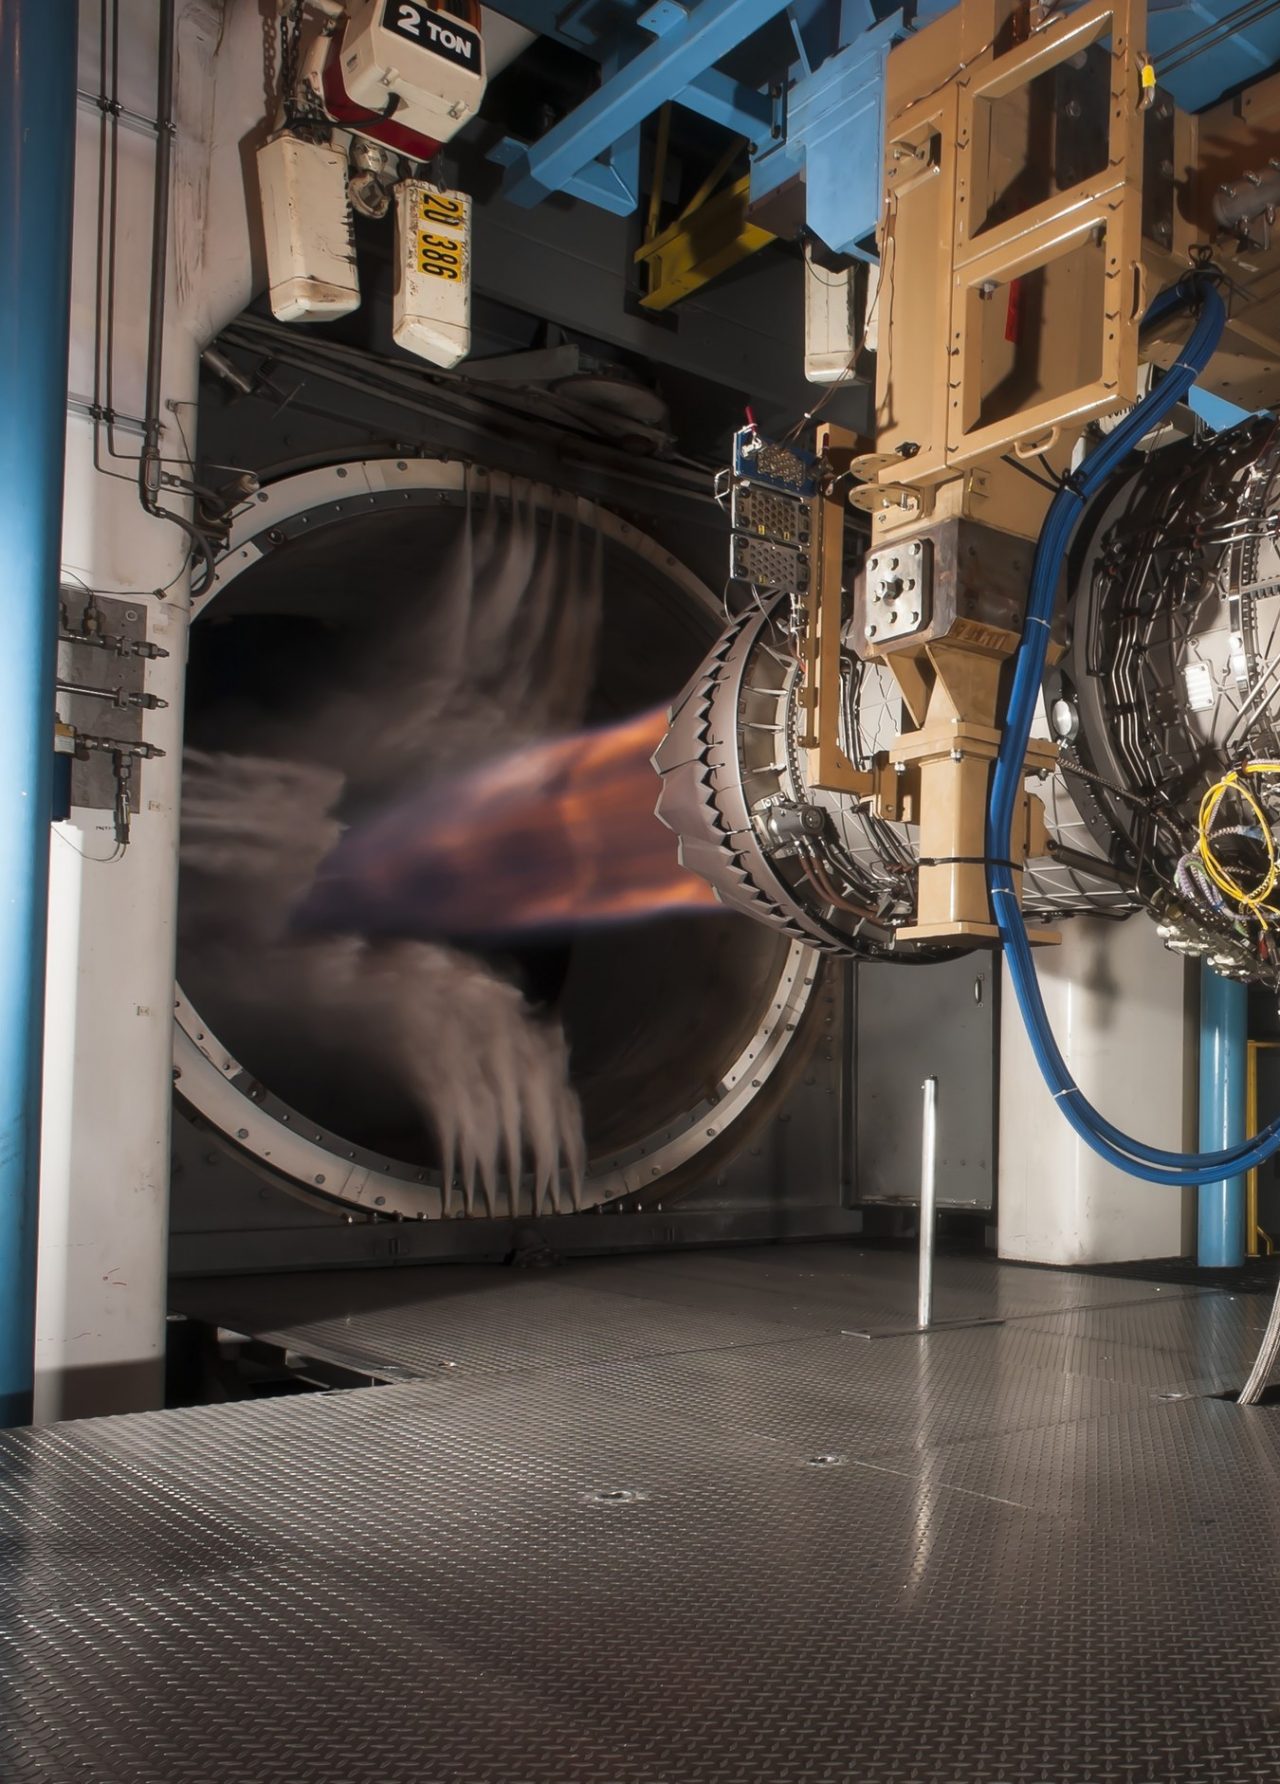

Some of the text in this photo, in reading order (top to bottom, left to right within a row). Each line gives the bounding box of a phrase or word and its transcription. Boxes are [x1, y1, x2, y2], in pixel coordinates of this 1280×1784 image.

[397, 4, 472, 58] 2 TON
[421, 193, 461, 279] 20 386
